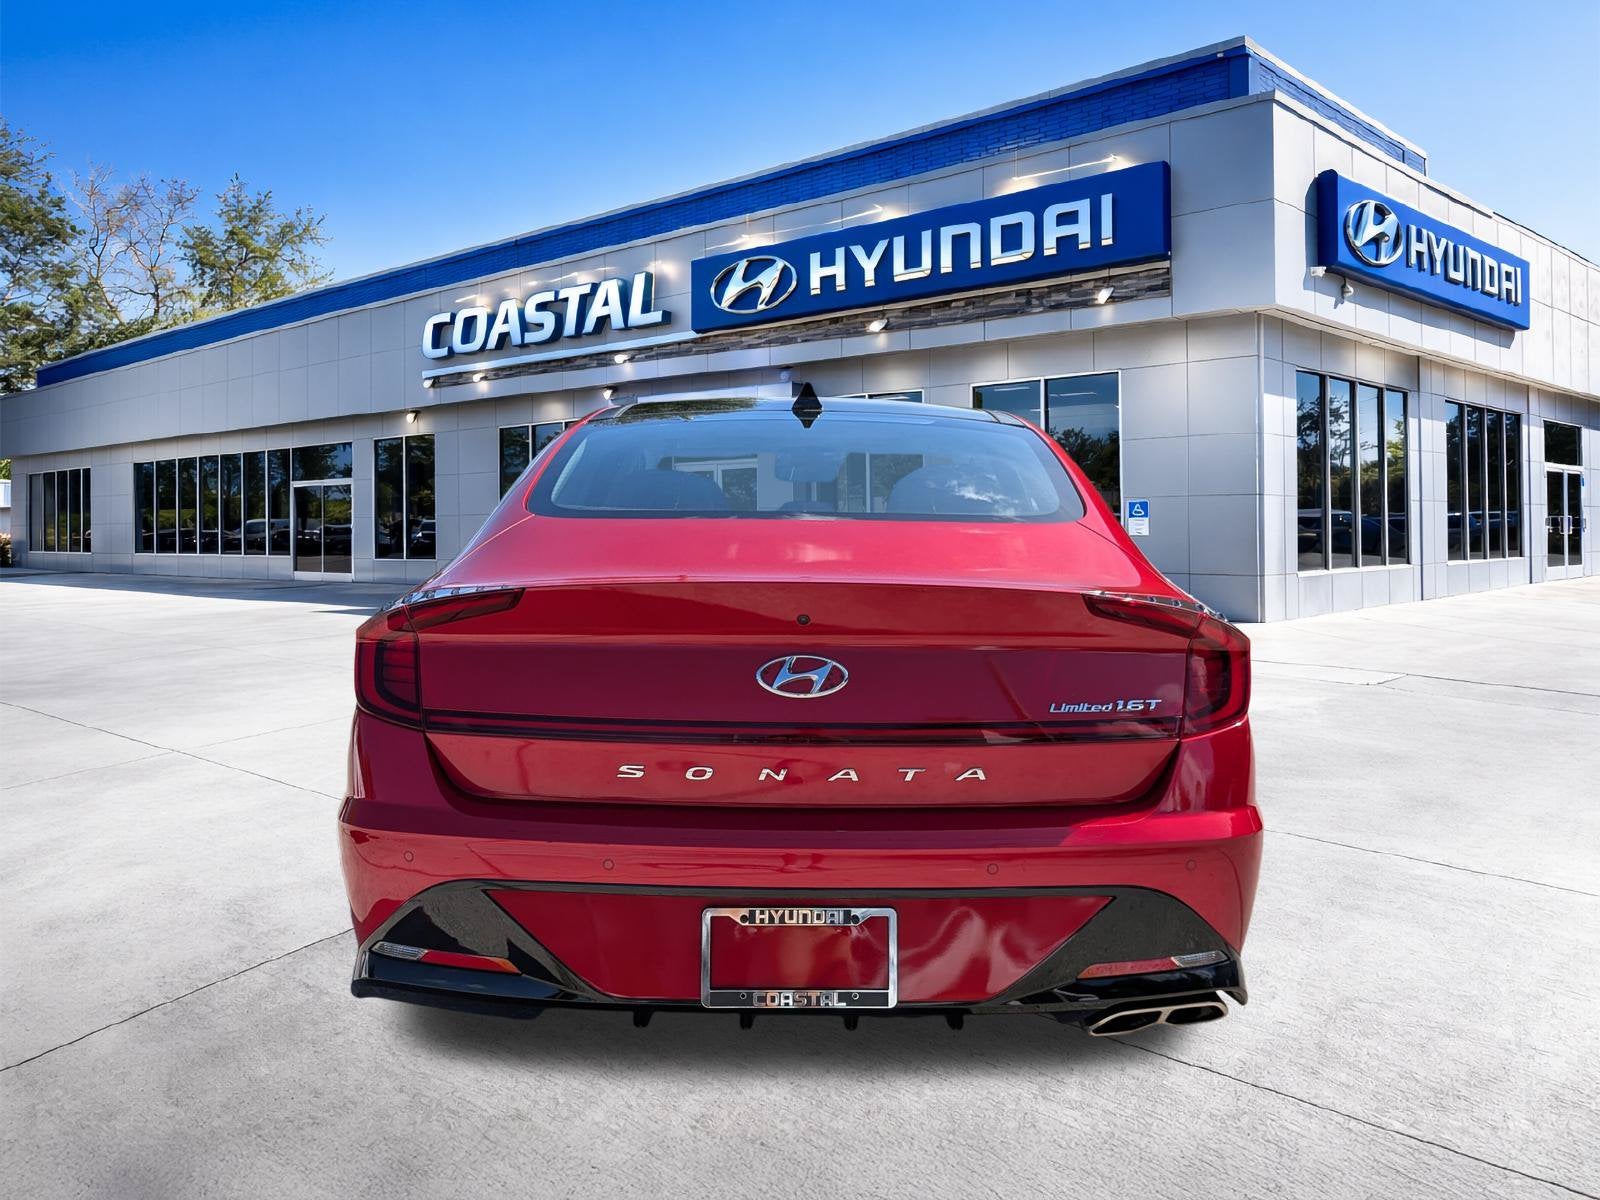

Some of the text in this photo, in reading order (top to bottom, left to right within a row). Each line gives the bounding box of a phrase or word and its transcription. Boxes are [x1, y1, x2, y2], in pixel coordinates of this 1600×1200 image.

[808, 193, 1114, 295] HYUNDAI
[1407, 224, 1522, 306] HYUNDAI
[421, 271, 664, 359] COASTAL
[1049, 702, 1113, 713] Limited
[616, 764, 987, 782] SONATA
[754, 909, 845, 924] HYUNDAI
[752, 991, 847, 1007] COASTAL
